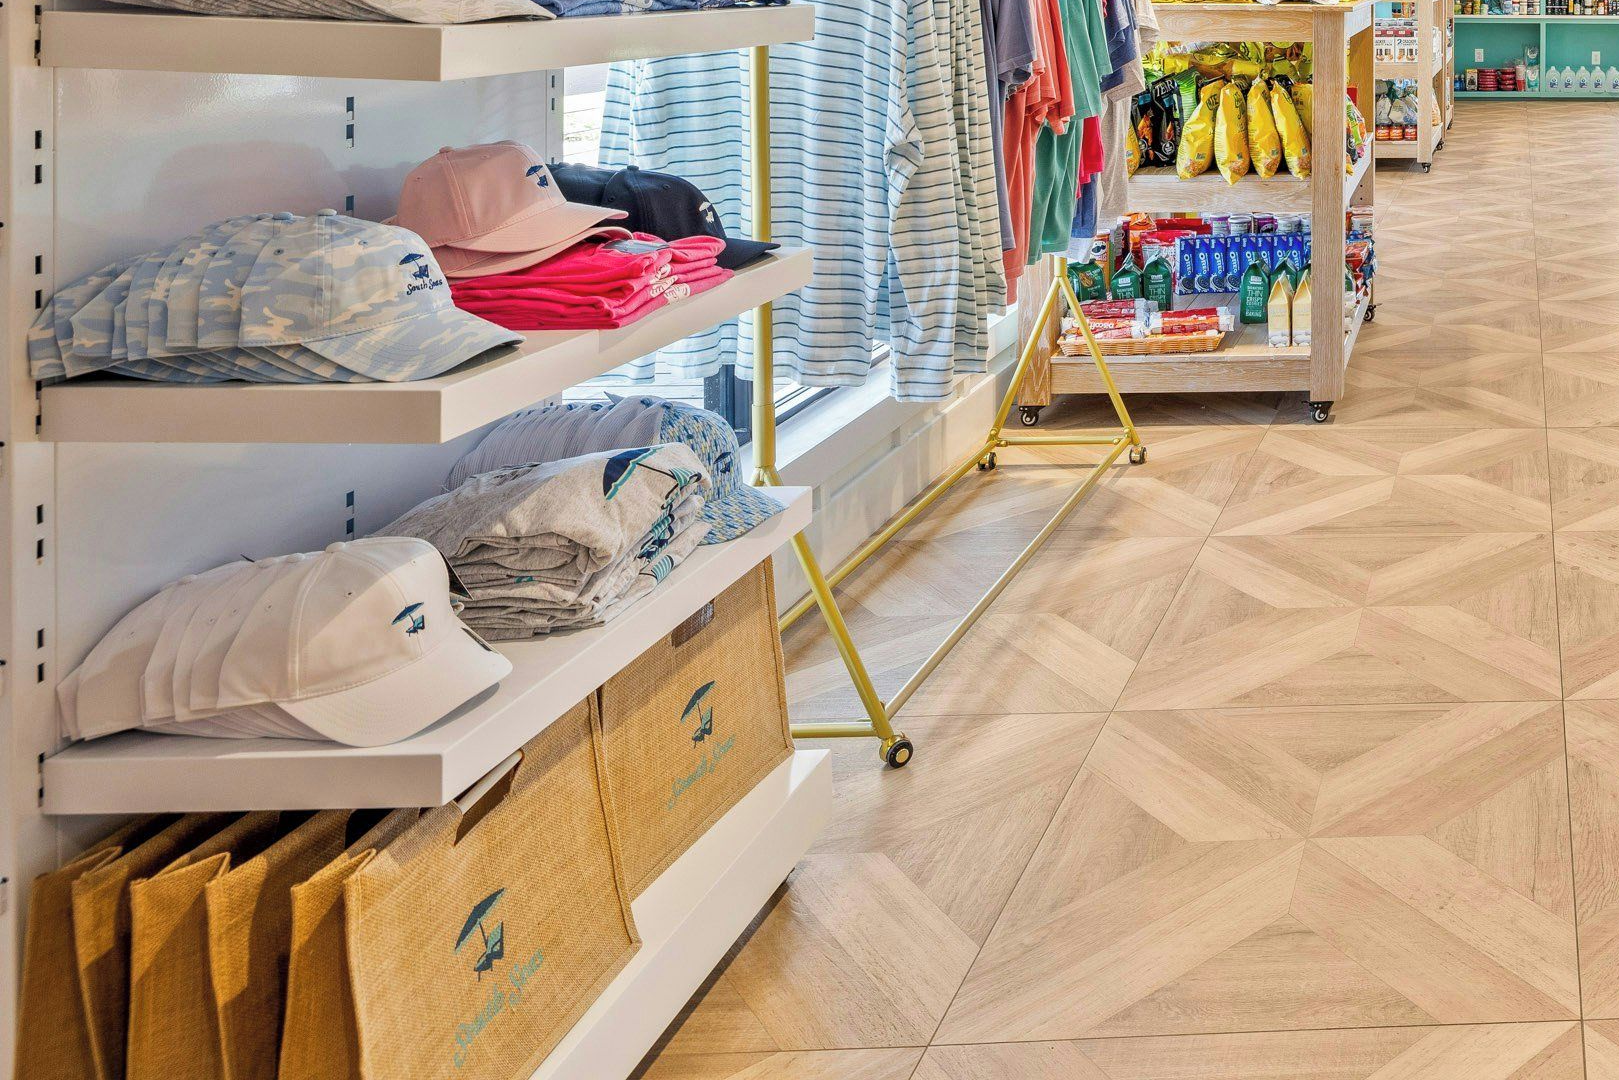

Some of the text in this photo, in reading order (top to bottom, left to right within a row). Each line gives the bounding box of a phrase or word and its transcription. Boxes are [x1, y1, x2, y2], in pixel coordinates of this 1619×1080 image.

[406, 278, 443, 296] South Seas
[453, 947, 545, 1070] South Seas
